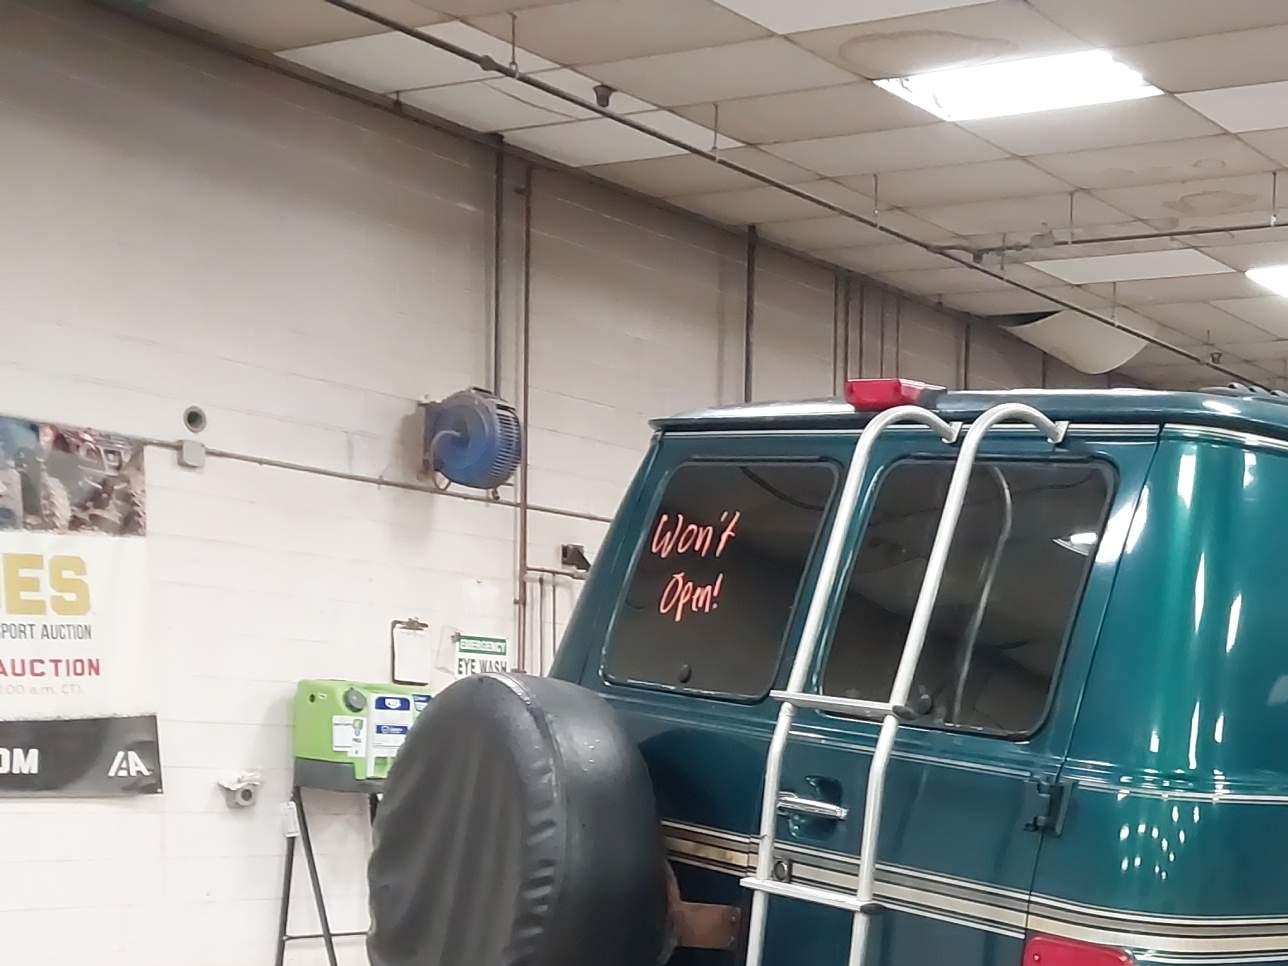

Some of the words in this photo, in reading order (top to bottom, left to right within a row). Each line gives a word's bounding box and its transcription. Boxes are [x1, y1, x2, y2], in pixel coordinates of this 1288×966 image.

[651, 511, 740, 558] Won't
[41, 623, 92, 640] AUCTION
[0, 658, 101, 677] AUCTION
[457, 657, 476, 675] EYE
[480, 659, 507, 673] WASH
